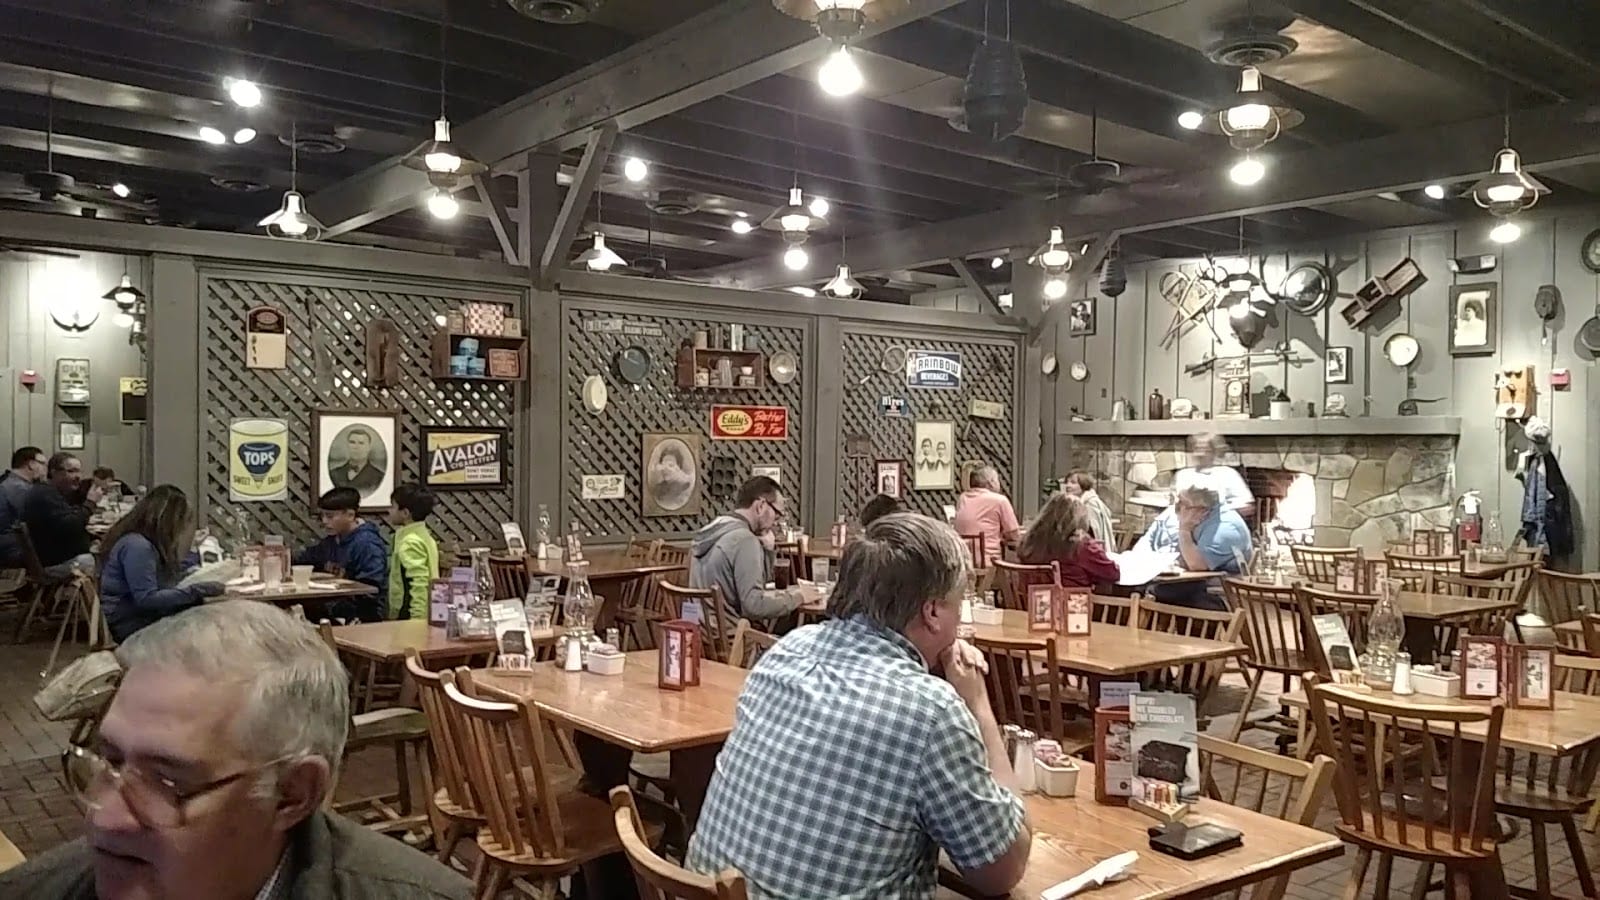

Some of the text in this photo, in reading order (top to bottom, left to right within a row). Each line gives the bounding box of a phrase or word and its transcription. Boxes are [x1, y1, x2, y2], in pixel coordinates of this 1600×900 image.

[918, 358, 959, 375] RAINBOW
[722, 413, 749, 426] Eddy's
[754, 410, 785, 422] Better
[243, 451, 275, 466] TOPS
[430, 440, 497, 475] AVALON
[449, 455, 495, 469] CIGARETTES
